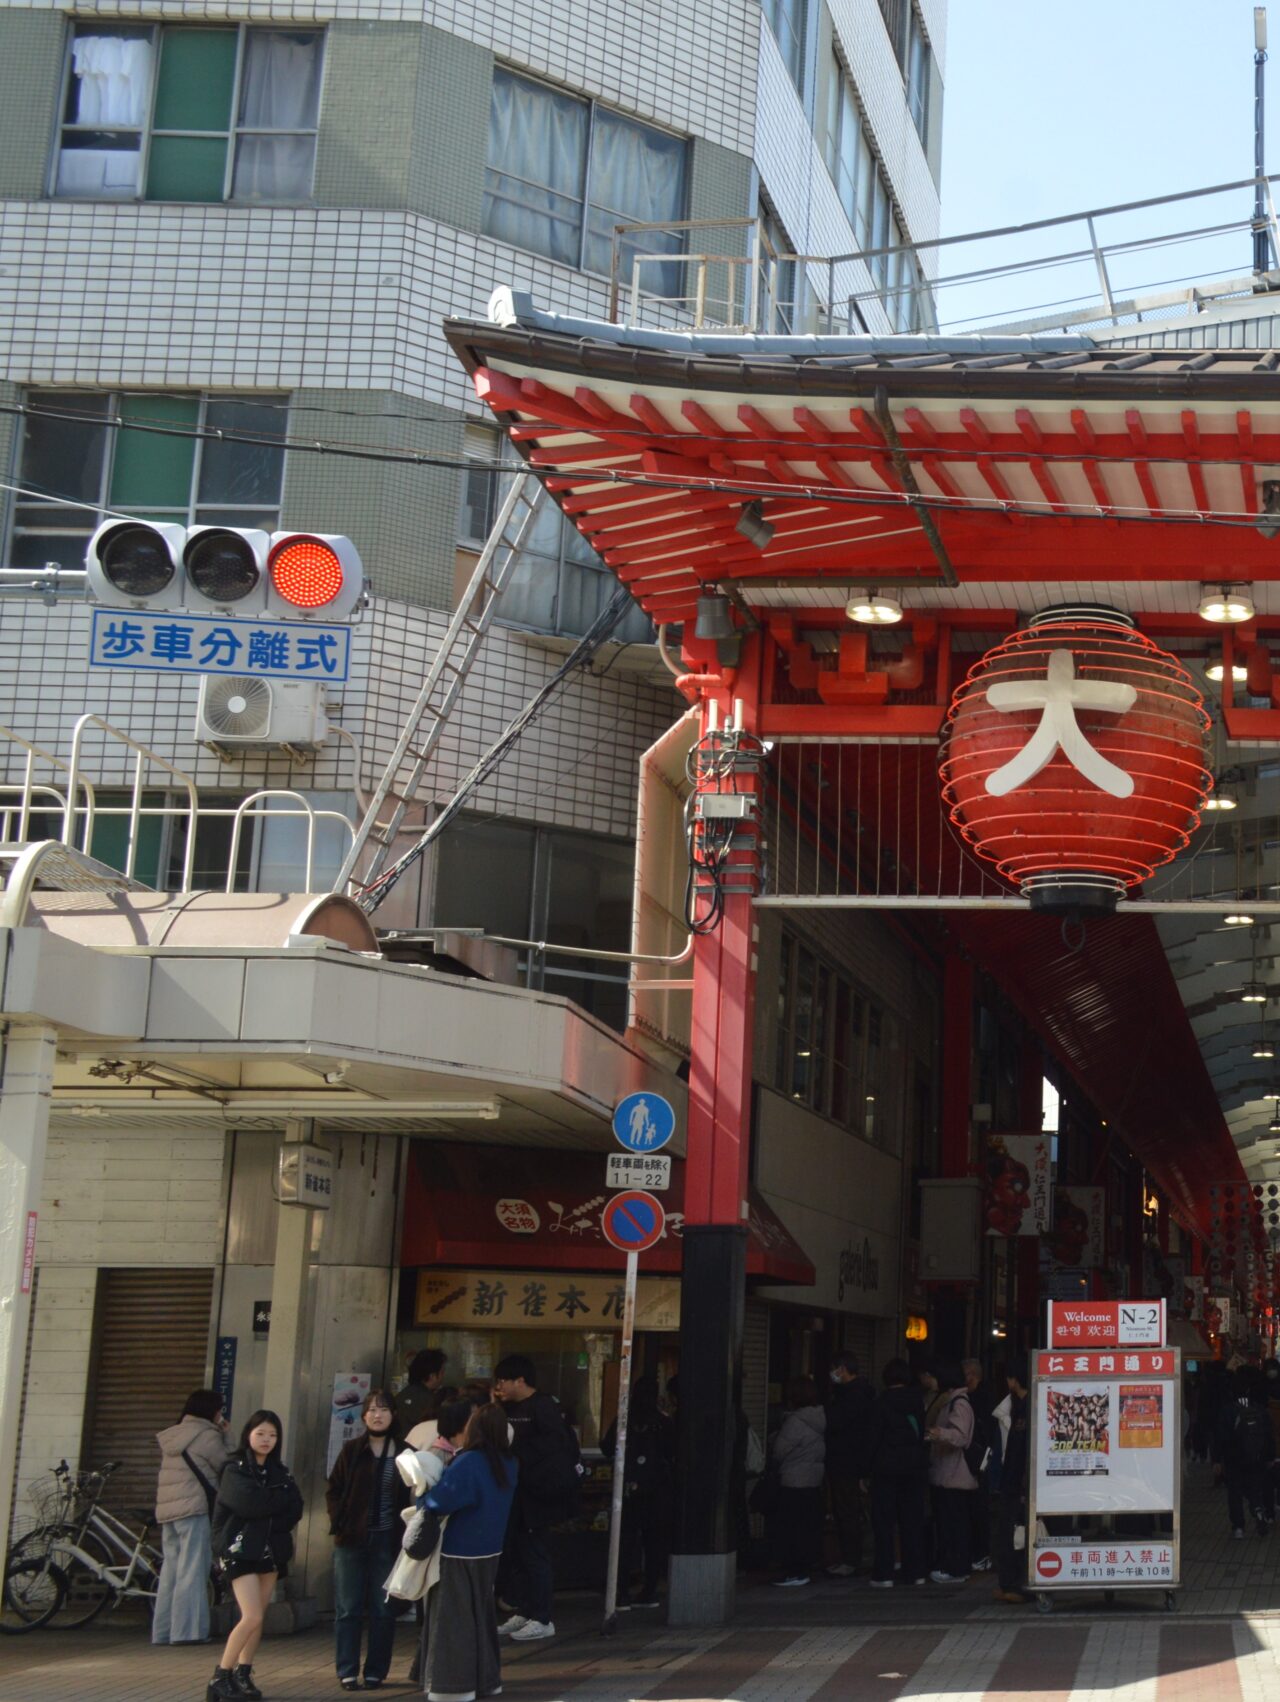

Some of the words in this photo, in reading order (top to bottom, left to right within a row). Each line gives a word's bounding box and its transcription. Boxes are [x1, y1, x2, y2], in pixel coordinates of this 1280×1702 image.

[101, 620, 338, 673] 歩車分離式
[984, 647, 1138, 799] 大
[610, 1156, 668, 1171] 軽車両を除く
[500, 1202, 532, 1215] 大須
[504, 1216, 537, 1230] 名物
[472, 1280, 627, 1320] 新雀本店
[1064, 1311, 1111, 1323] Welcome
[1121, 1308, 1159, 1325] N-2
[1087, 1324, 1116, 1337] 欢迎
[1048, 1354, 1164, 1373] 仁王門通り
[1077, 1440, 1107, 1453] TEAM
[1070, 1549, 1171, 1565] 車両進入禁止
